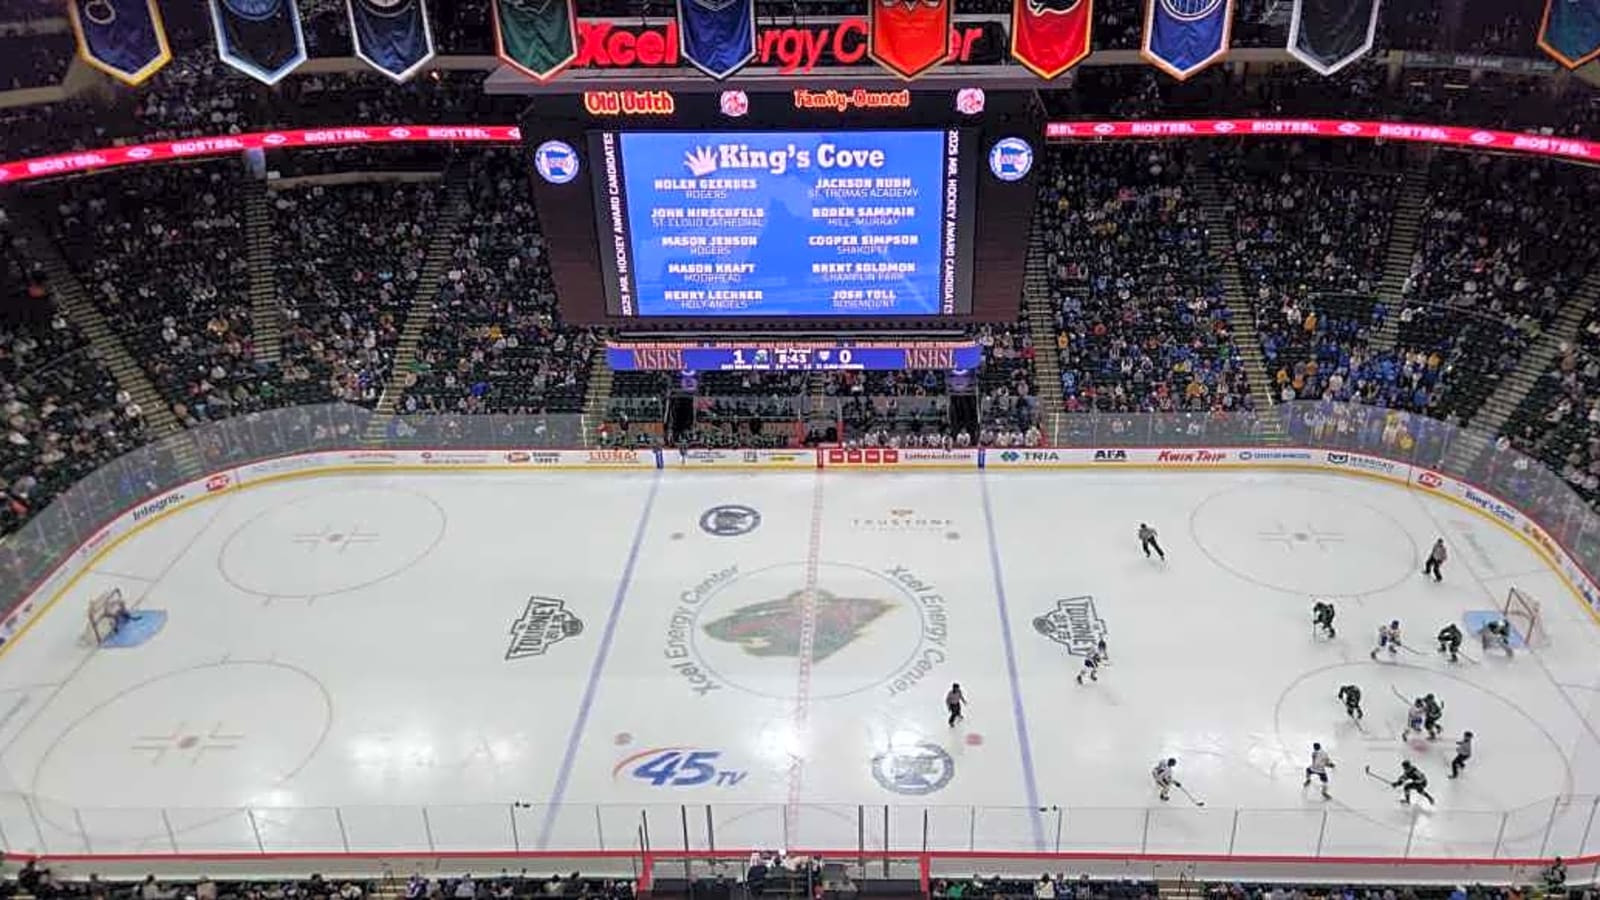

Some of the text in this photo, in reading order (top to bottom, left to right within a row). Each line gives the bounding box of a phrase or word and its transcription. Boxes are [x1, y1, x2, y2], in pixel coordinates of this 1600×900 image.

[577, 19, 678, 66] Xcel
[584, 90, 674, 114] Old Dutch
[304, 128, 368, 143] BIOSTEEL
[427, 127, 491, 139] BIOSTEEL
[1132, 123, 1195, 135] BIOSTEEL
[1252, 121, 1319, 134] BIOSTEEL
[1379, 125, 1447, 140] BIOSTEEL
[171, 137, 243, 153] BIOSTEEL
[1513, 136, 1590, 156] BIOSTEEL
[27, 153, 107, 174] BIOSTEEL
[718, 144, 884, 174] King's Cove
[947, 179, 957, 219] HOCKEY
[611, 197, 624, 233] AWARD
[945, 221, 956, 256] AWARD
[615, 235, 627, 273] HOCKEY
[633, 349, 687, 369] MSHSL
[733, 350, 745, 364] 1
[839, 350, 851, 363] 0
[904, 349, 957, 369] MSHSL
[1023, 452, 1059, 461] TRIA
[1094, 449, 1127, 459] AFA
[681, 564, 739, 604] Center
[886, 564, 931, 594] Xcel
[921, 586, 948, 645] Energy
[512, 602, 559, 654] TOURNEY
[664, 606, 690, 660] Energy
[671, 661, 724, 696] Xcel
[887, 648, 945, 696] Center
[633, 750, 748, 787] 45 TV
